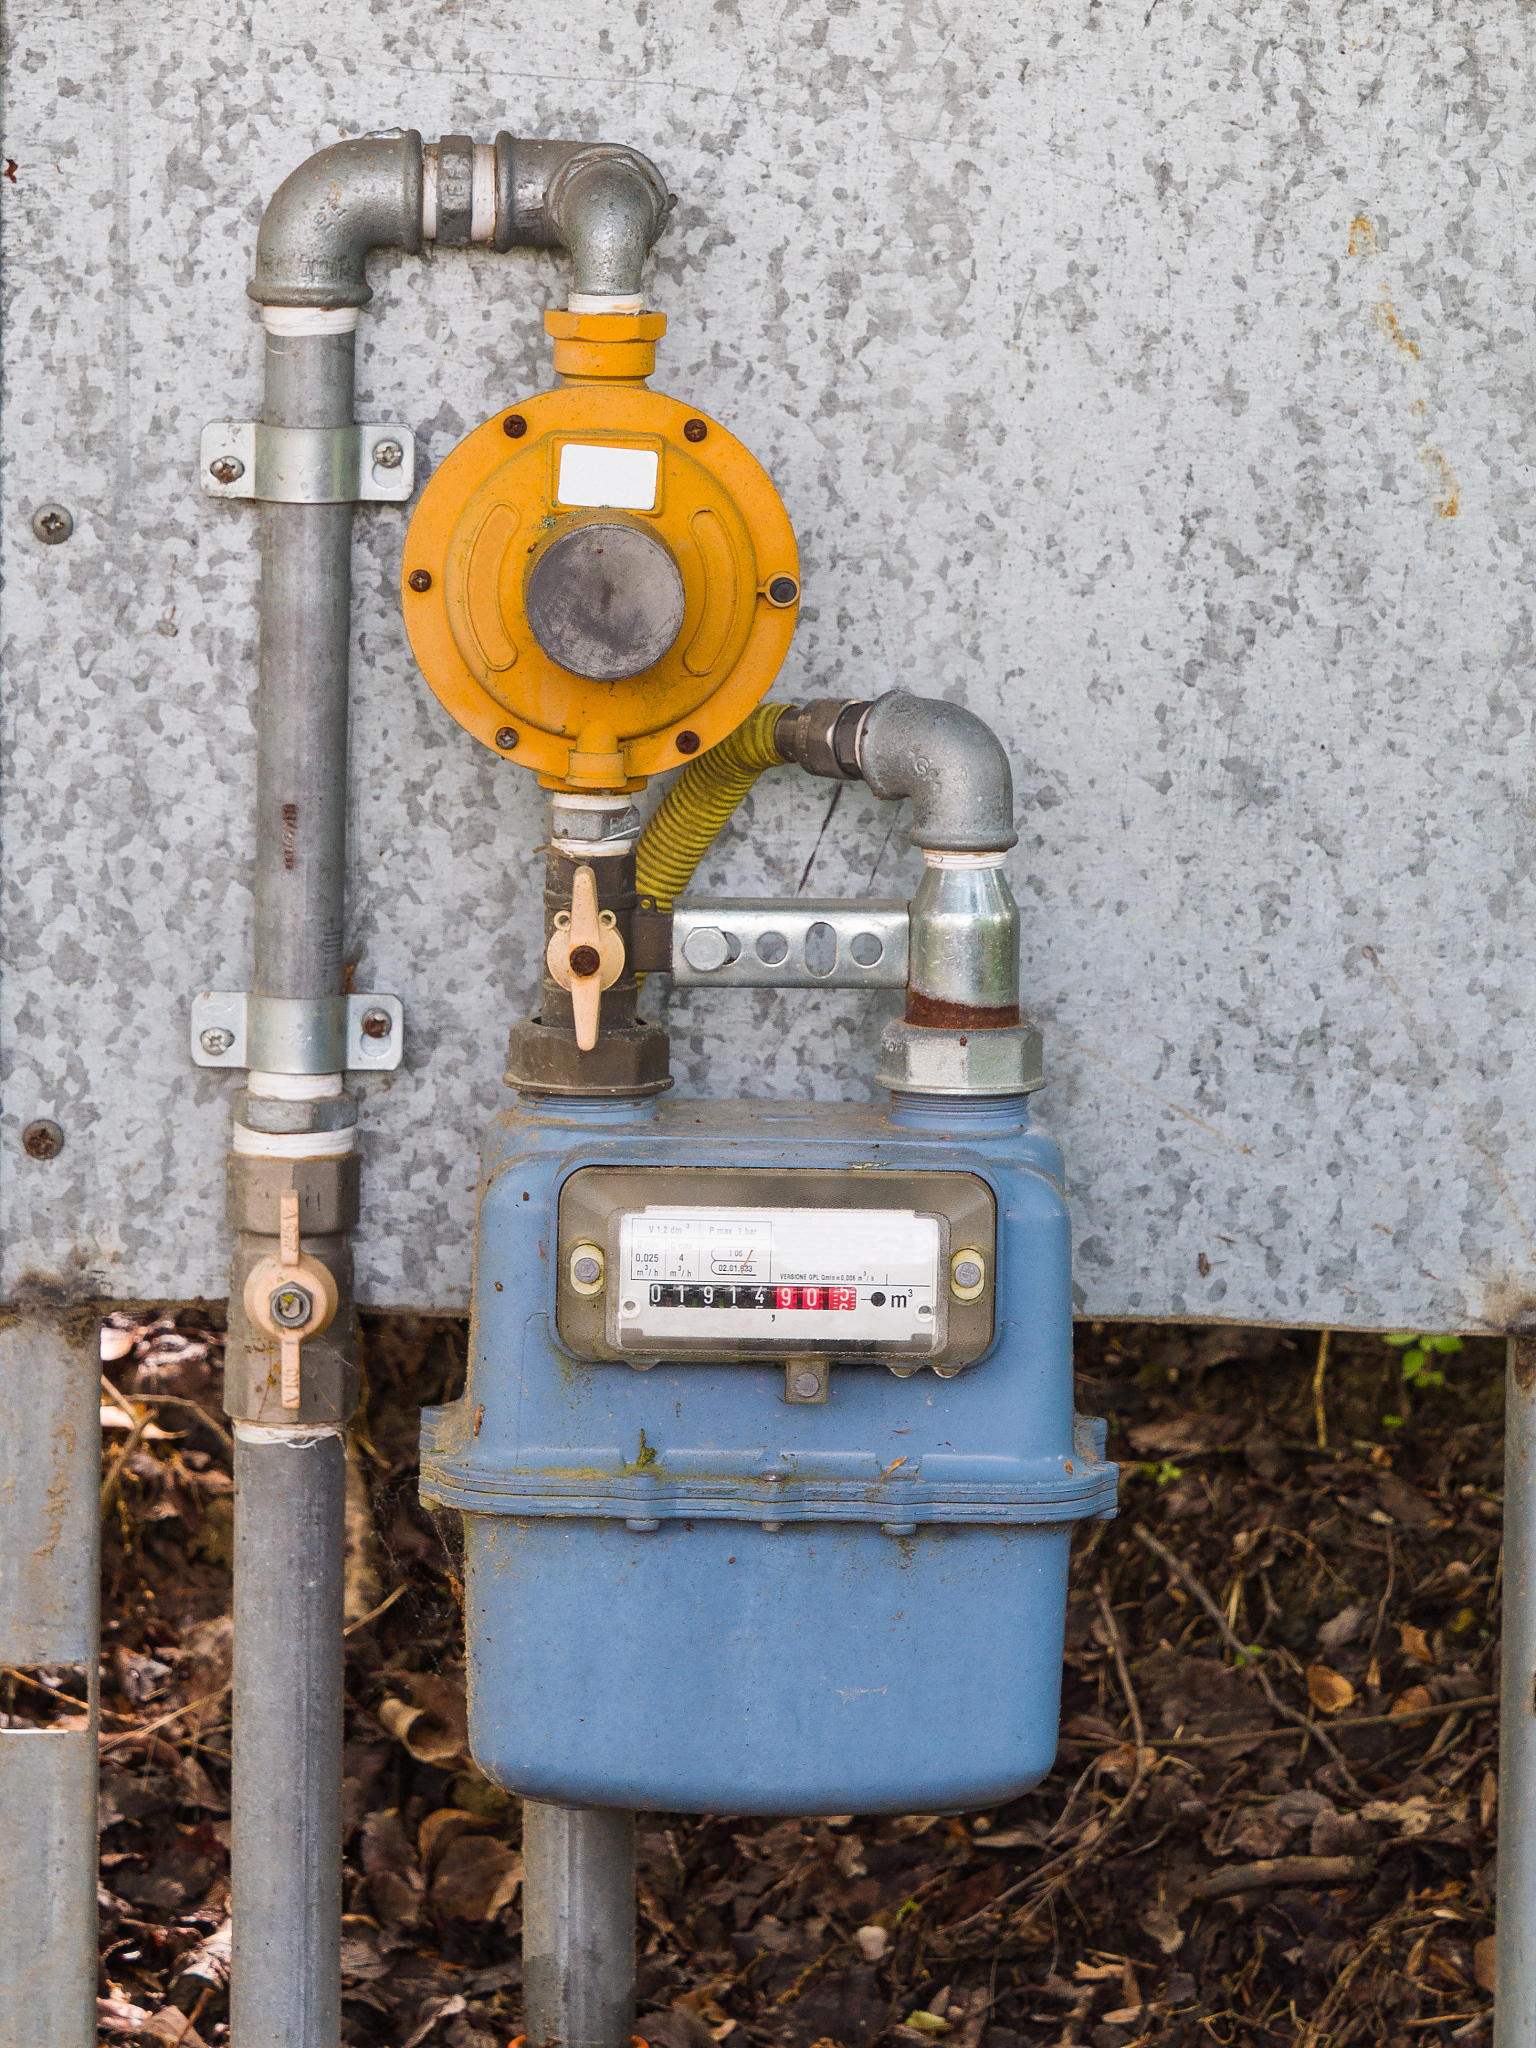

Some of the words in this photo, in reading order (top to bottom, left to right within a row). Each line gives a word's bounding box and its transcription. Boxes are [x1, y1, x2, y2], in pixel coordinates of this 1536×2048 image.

[717, 1228, 733, 1236] max
[745, 1227, 757, 1236] bar
[635, 1253, 659, 1263] 0,025
[679, 1253, 685, 1262] 4
[780, 1273, 807, 1281] VERSIONE
